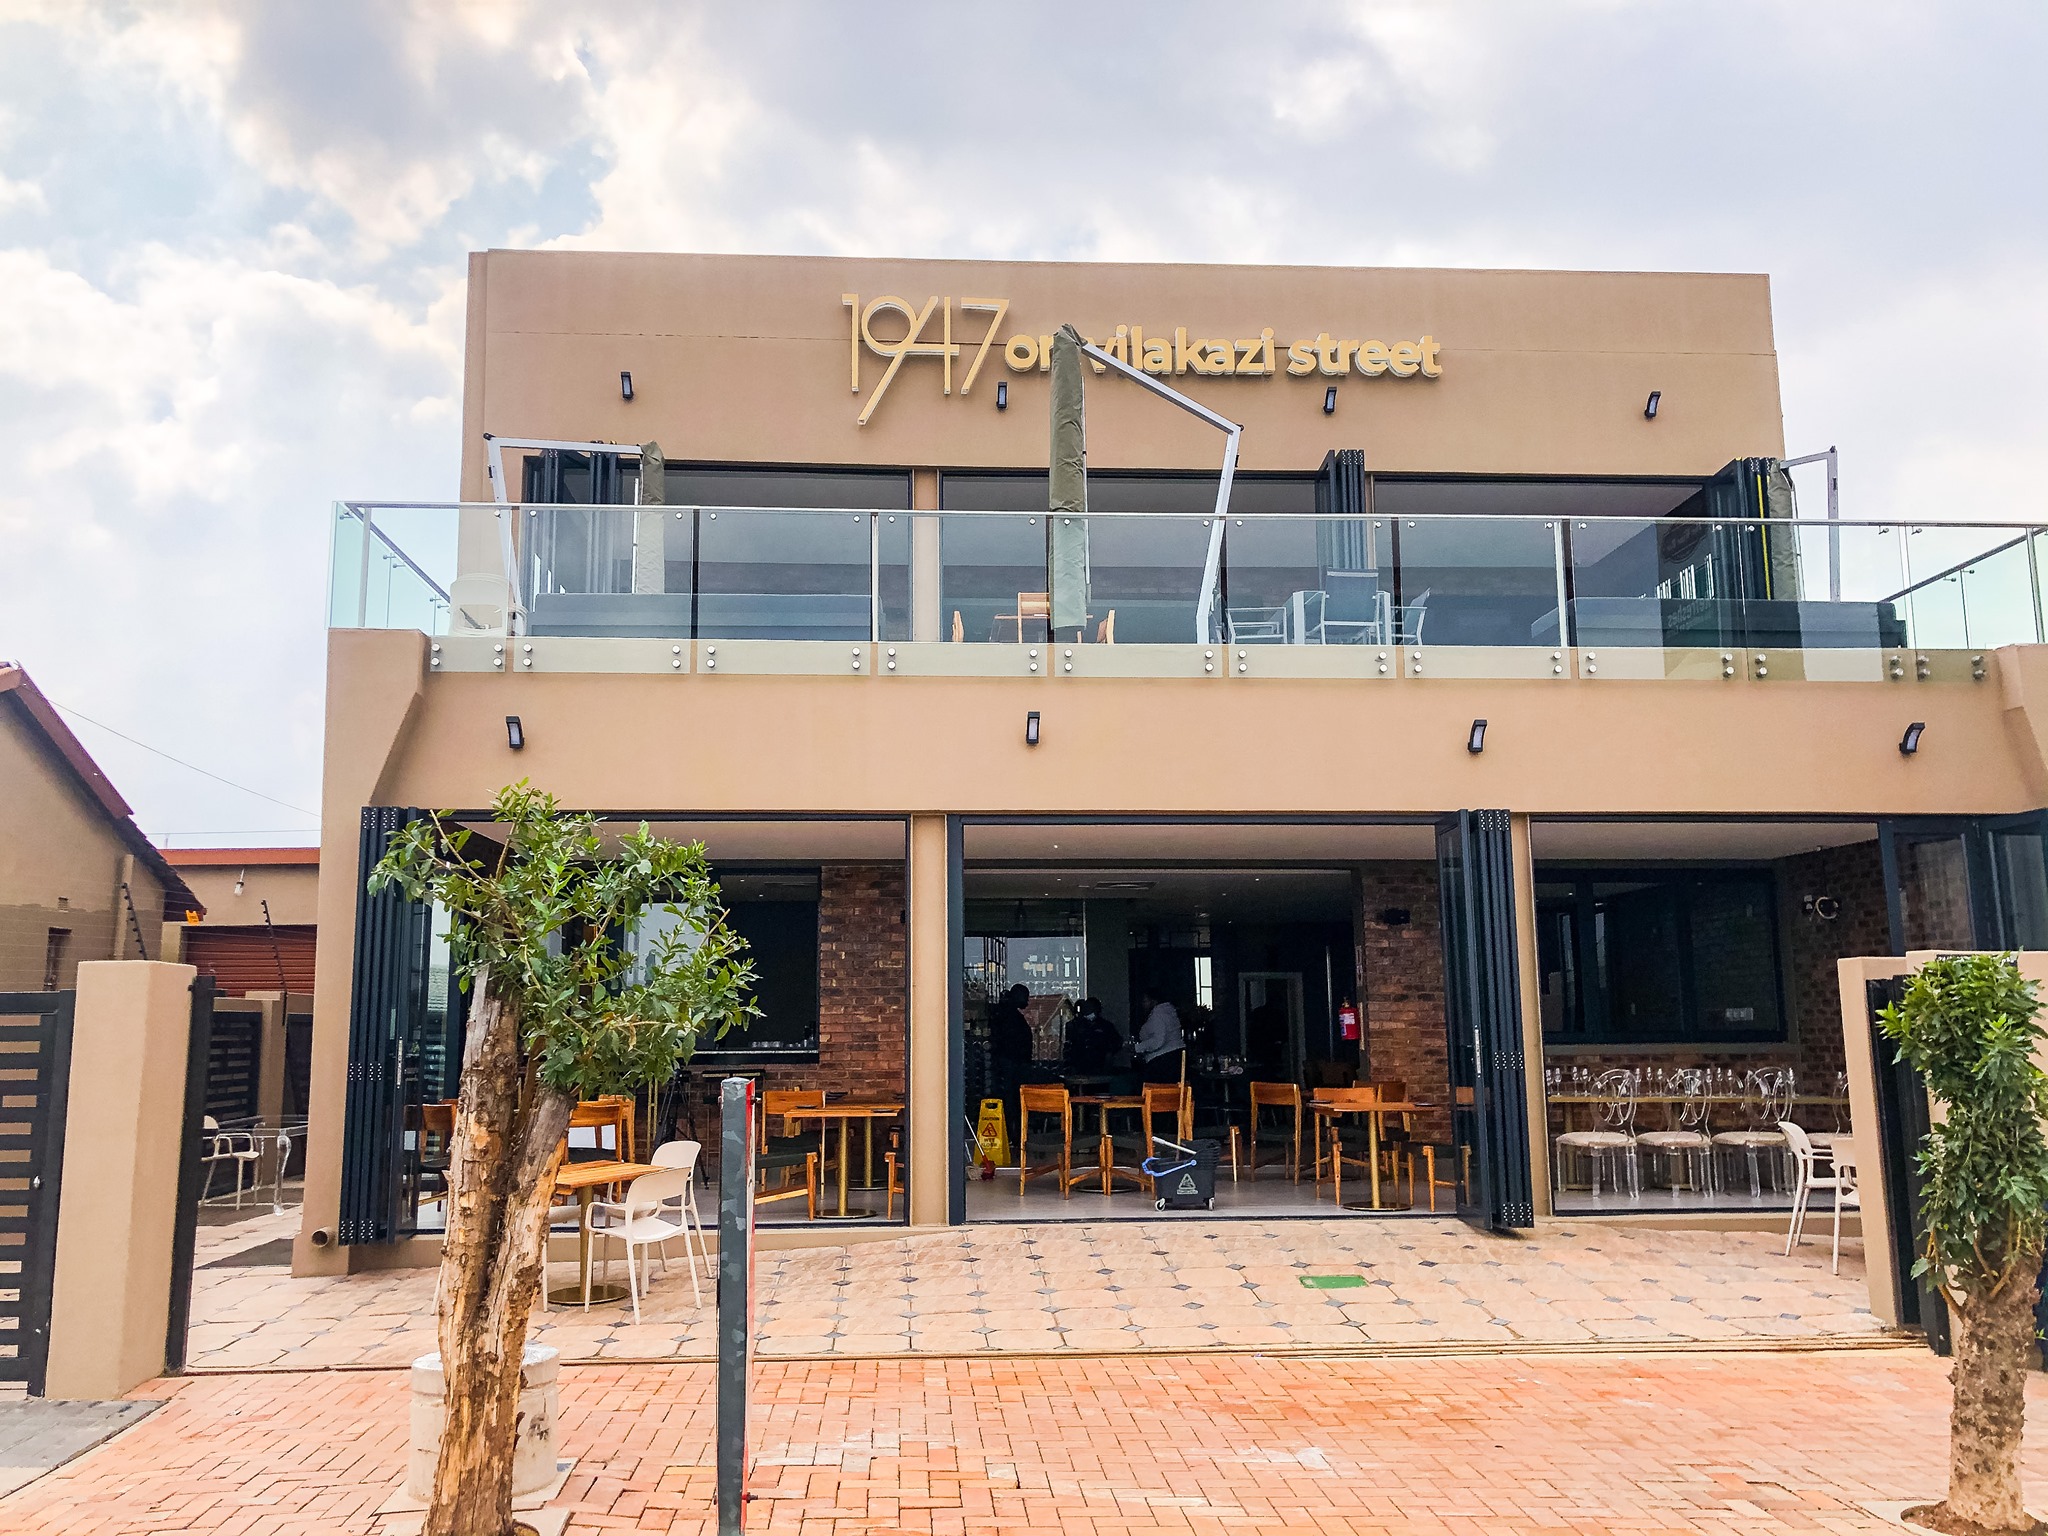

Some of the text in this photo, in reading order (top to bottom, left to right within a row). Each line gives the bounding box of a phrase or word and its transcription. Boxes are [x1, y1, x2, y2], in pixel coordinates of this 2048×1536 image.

[841, 293, 1010, 426] 1947
[1082, 324, 1275, 377] vilakazi
[1286, 332, 1443, 379] street
